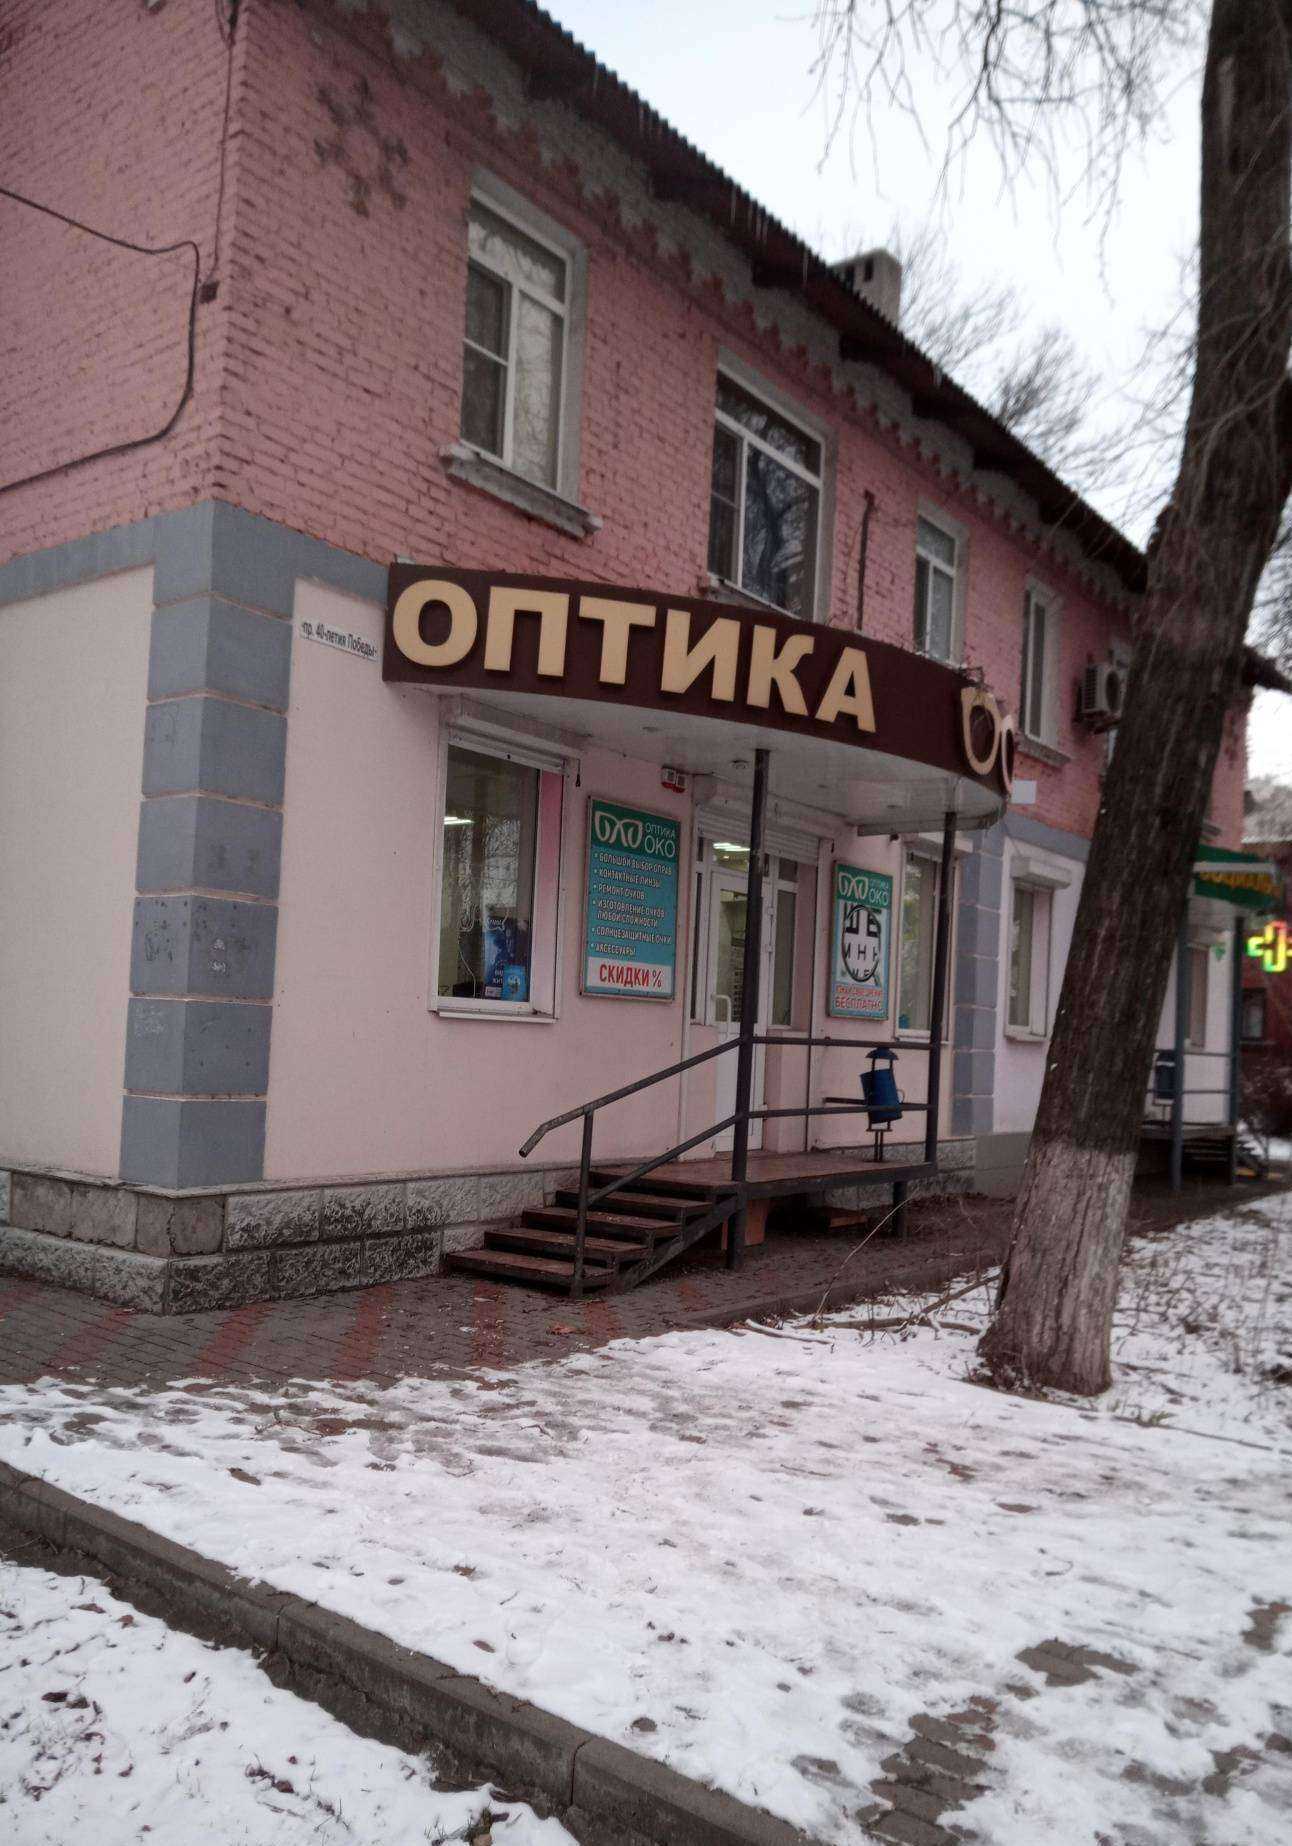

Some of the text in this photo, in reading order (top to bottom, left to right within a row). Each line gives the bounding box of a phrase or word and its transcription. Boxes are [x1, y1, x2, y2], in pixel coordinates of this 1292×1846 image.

[316, 623, 346, 647] 40-летия
[392, 579, 876, 733] ОПТИКА
[645, 822, 675, 838] ОПТИКА
[644, 835, 675, 858] ОКО
[599, 964, 662, 988] СКИДКИ %
